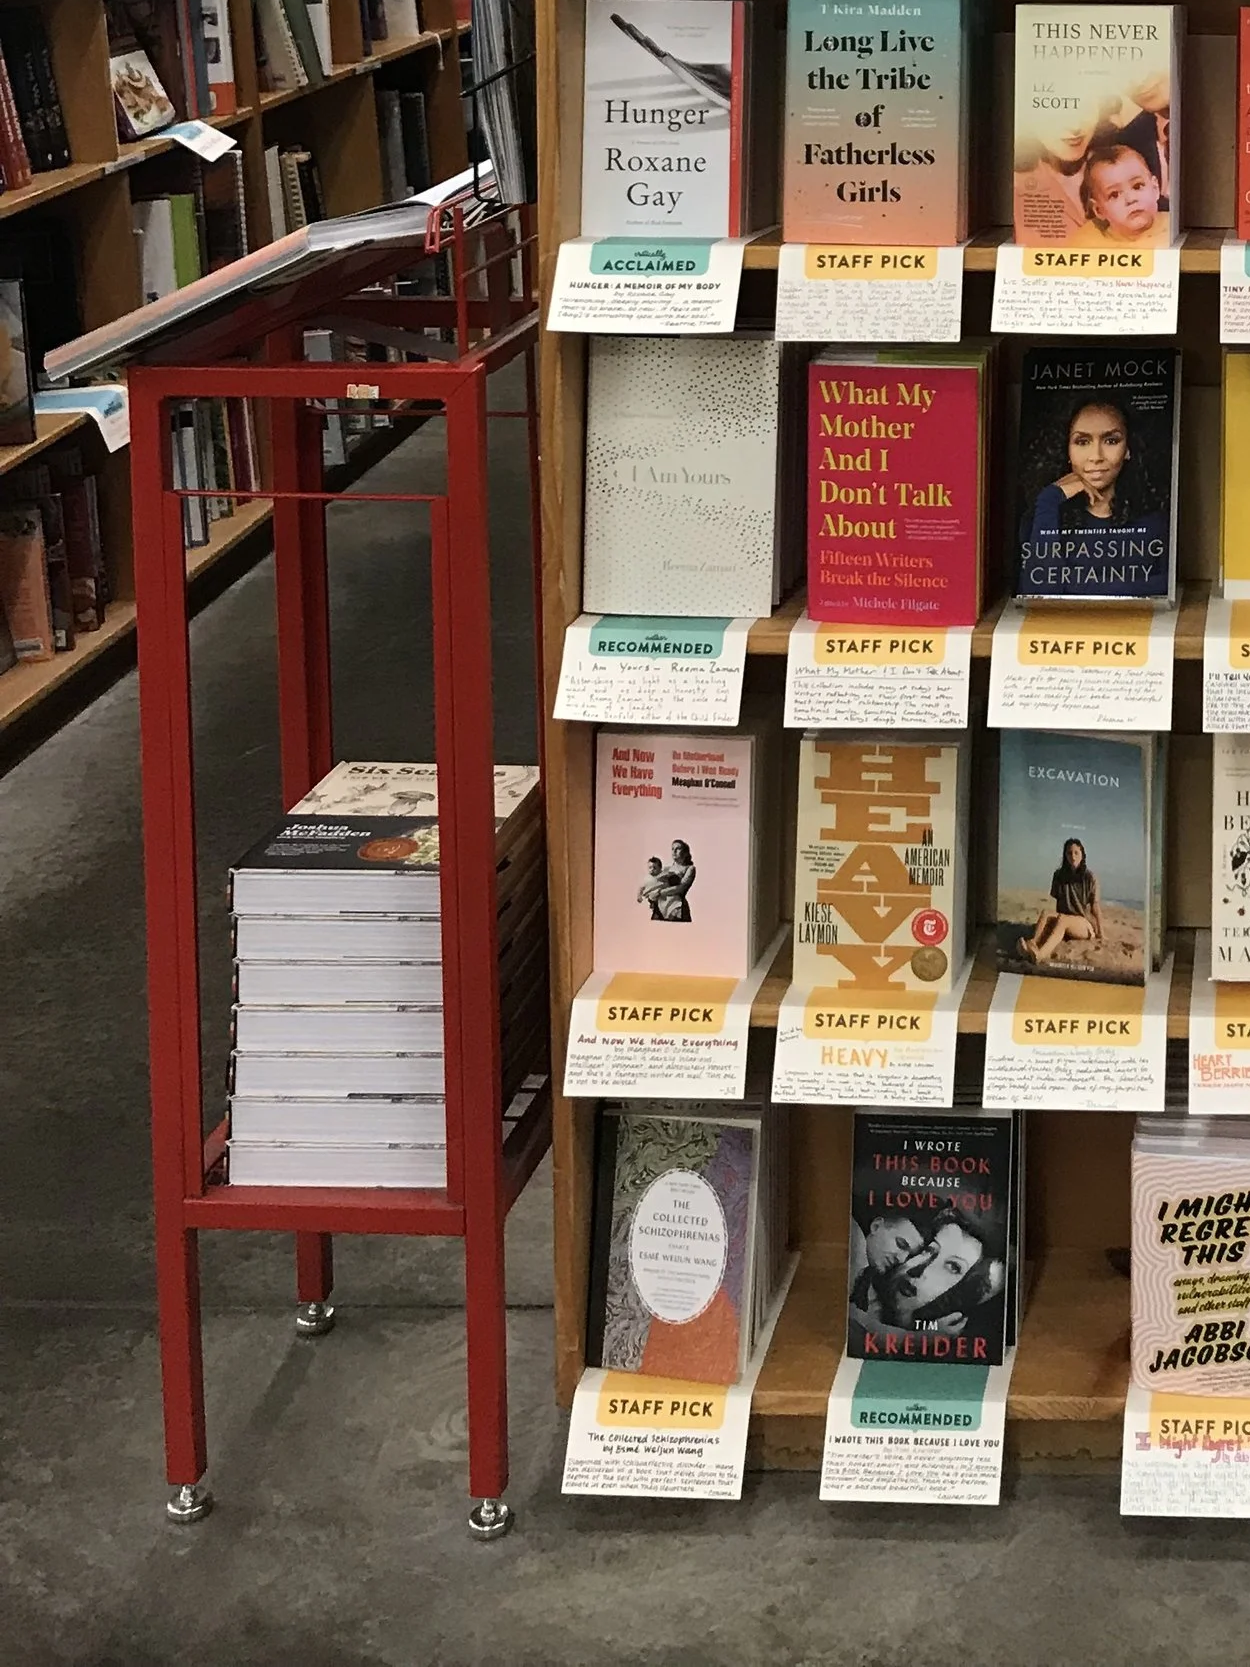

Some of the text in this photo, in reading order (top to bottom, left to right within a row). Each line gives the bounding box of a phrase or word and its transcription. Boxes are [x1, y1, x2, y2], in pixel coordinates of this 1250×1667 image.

[1032, 23, 1159, 41] THIS NEVER
[804, 31, 935, 59] Long Live
[605, 100, 709, 130] Hunger
[605, 148, 706, 172] Roxane
[804, 143, 935, 165] Fatherless
[837, 180, 901, 203] Girls
[603, 260, 696, 271] ACCLAIMED
[1030, 360, 1168, 381] JANET MOCK
[819, 381, 936, 412] What My
[820, 415, 915, 439] Mother
[820, 481, 952, 507] Don't Talk
[1021, 539, 1164, 560] SURPASSING
[612, 748, 655, 763] And Now
[1029, 766, 1120, 788] EXCAVATION
[612, 783, 662, 800] Everything
[905, 848, 950, 867] AMERICAN
[799, 923, 837, 945] LAYMON
[608, 1007, 713, 1021] STAFF PICK
[822, 1046, 888, 1068] HEAVY
[873, 1154, 989, 1174] THIS BOOK
[901, 1176, 960, 1188] BECAUSE
[673, 1200, 690, 1209] THE
[1158, 1202, 1167, 1220] I
[653, 1213, 708, 1226] COLLECTED
[639, 1226, 720, 1242] SCHIZOPHRENIAS
[864, 1334, 987, 1358] KREIDER
